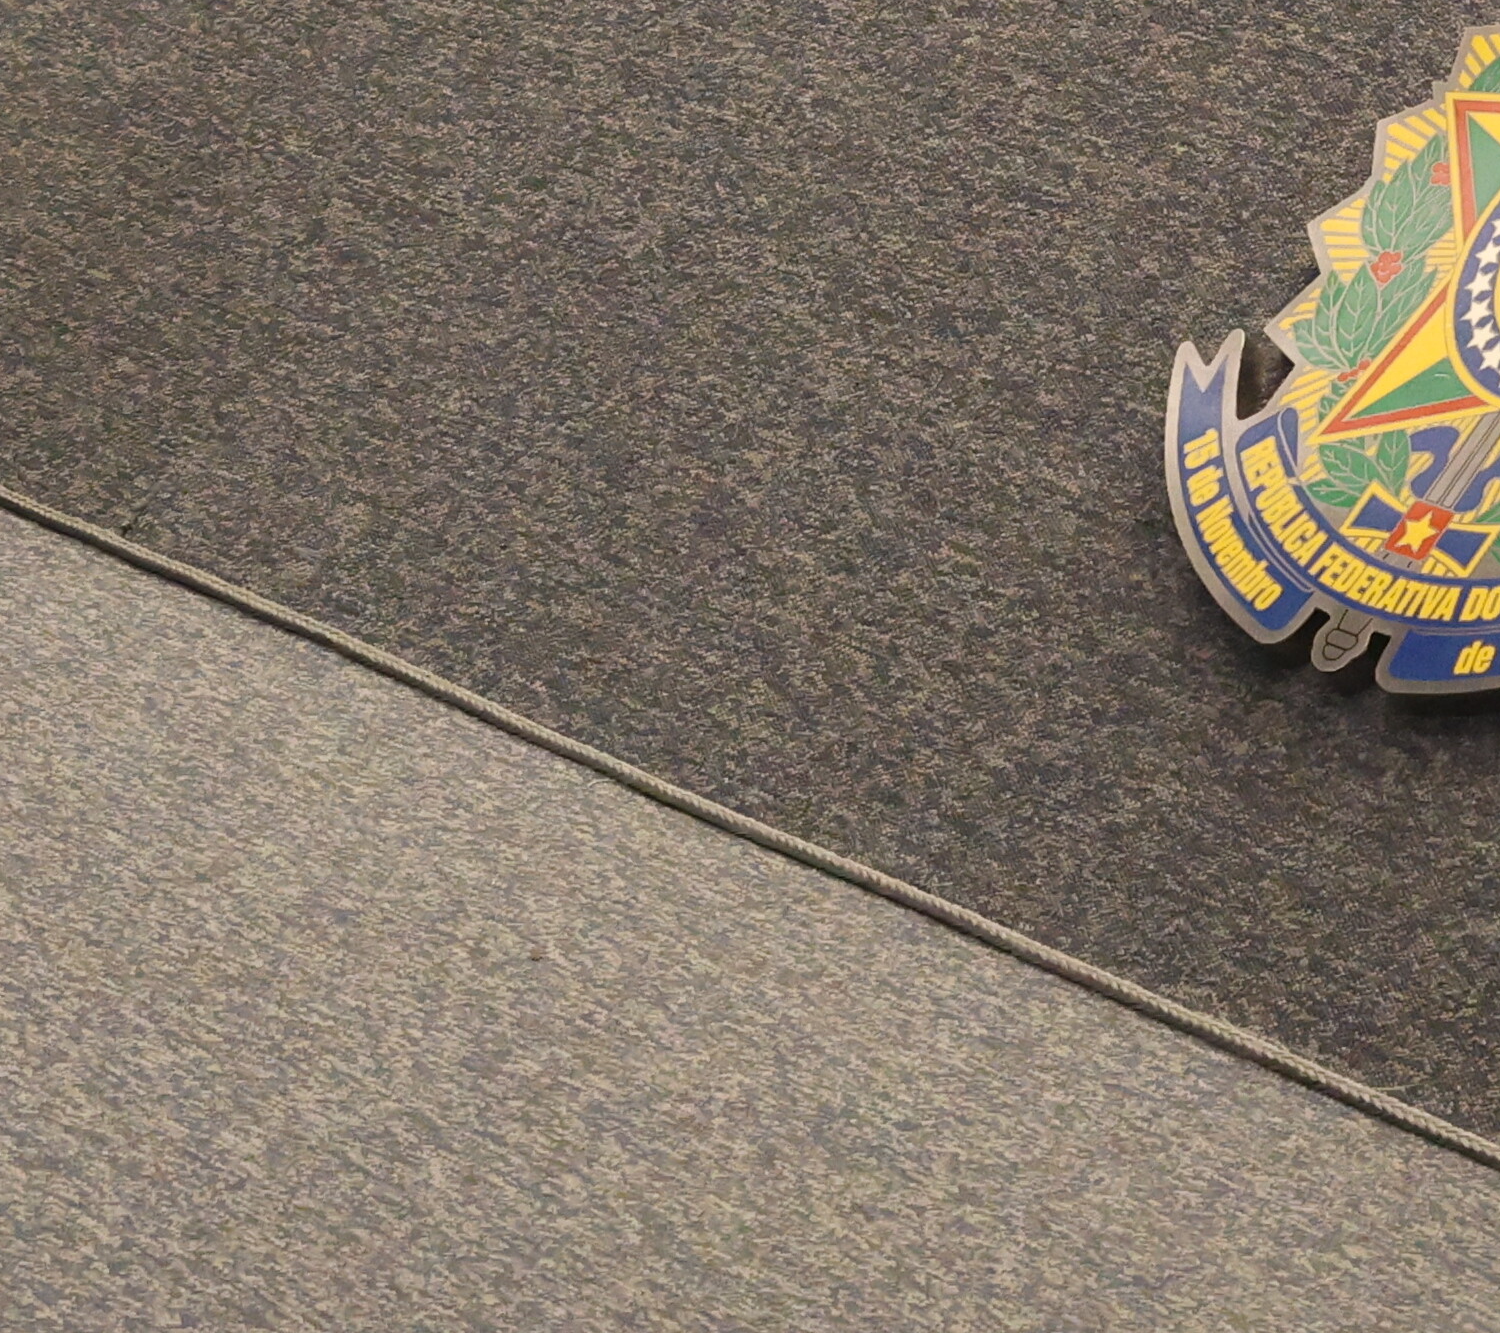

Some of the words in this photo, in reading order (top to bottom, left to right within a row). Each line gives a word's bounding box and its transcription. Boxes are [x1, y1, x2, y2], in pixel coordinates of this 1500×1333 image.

[1183, 427, 1221, 469] 15
[1187, 465, 1224, 507] de
[1195, 494, 1284, 612] Novembro
[1307, 541, 1464, 622] FEDERATIVA
[1453, 639, 1497, 676] de
